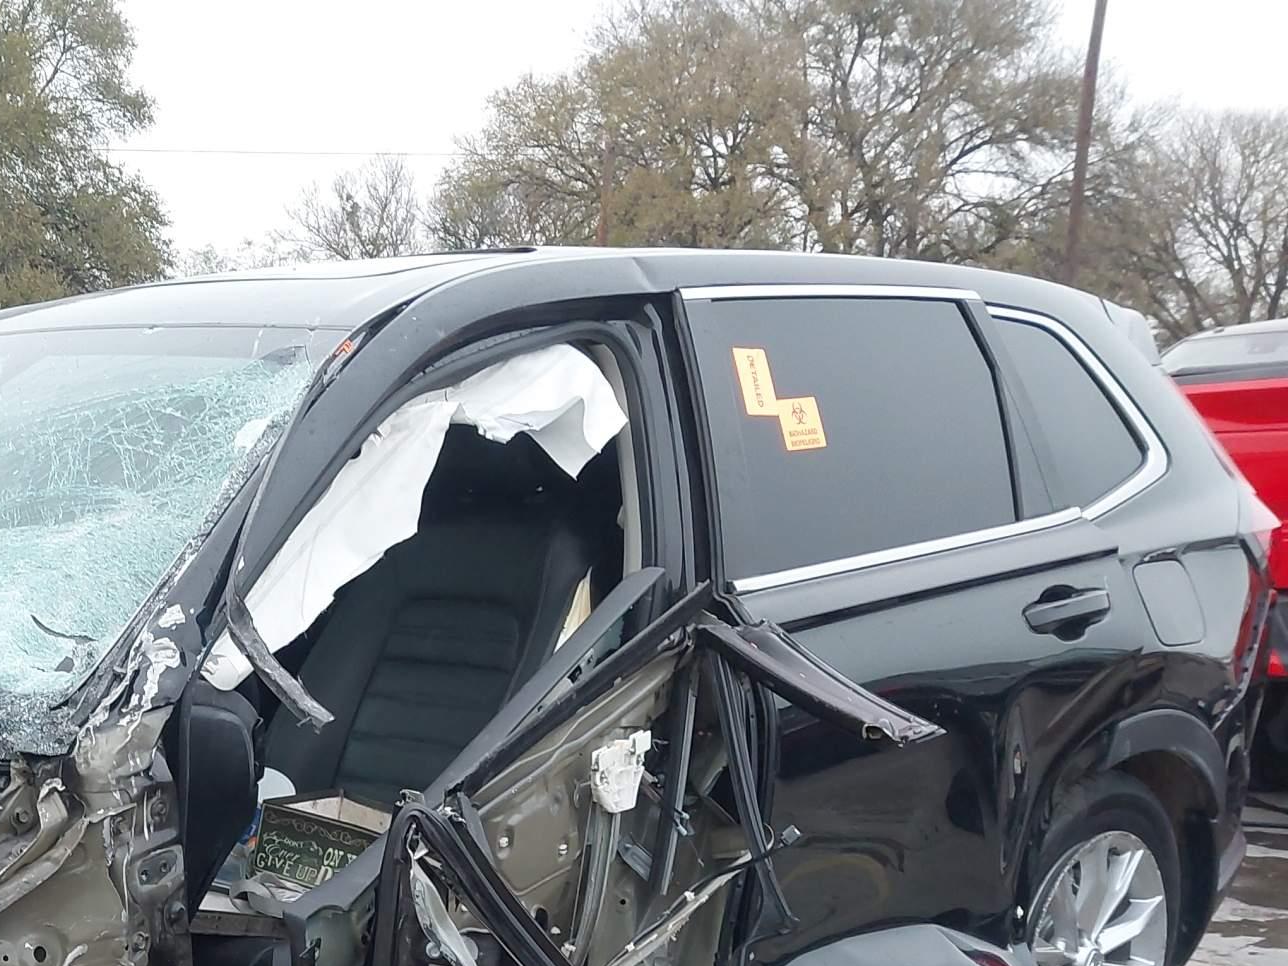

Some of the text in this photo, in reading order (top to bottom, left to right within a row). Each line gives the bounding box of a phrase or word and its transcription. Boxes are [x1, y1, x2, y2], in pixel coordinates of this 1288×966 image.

[747, 355, 764, 408] DETAILED
[323, 847, 345, 868] ON
[296, 863, 318, 881] UP
